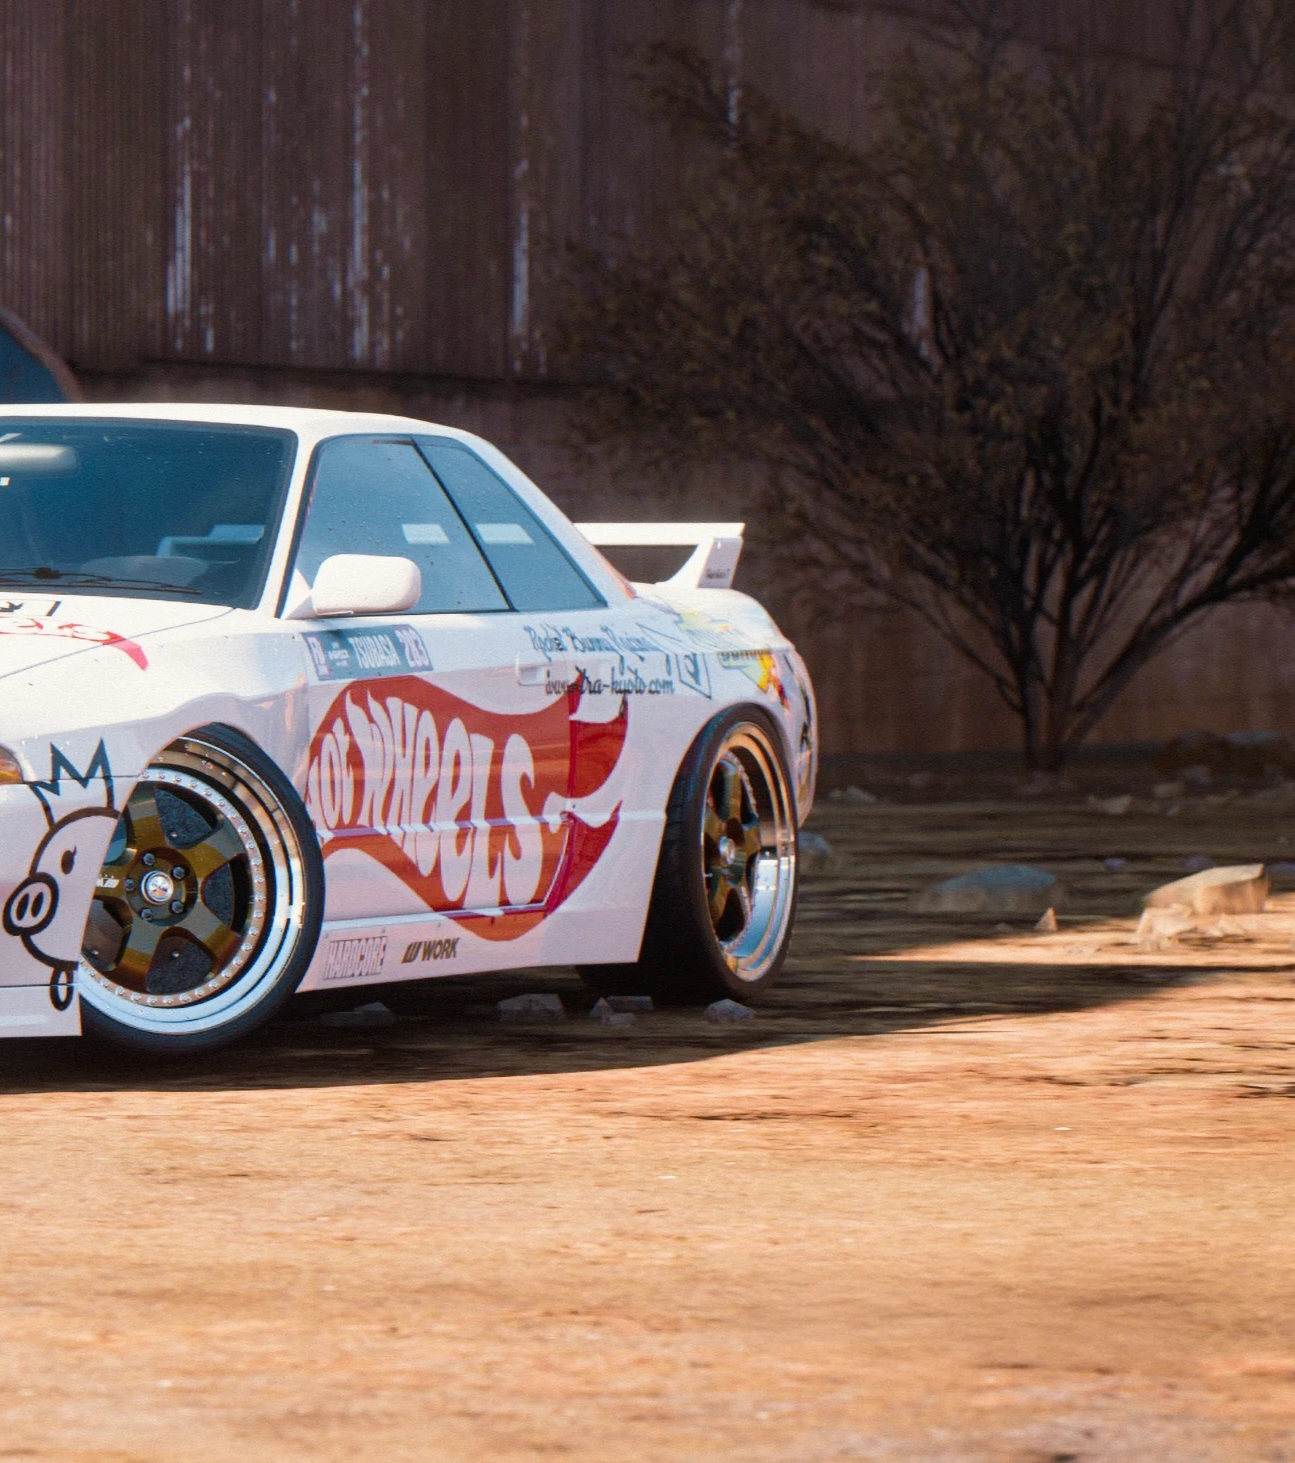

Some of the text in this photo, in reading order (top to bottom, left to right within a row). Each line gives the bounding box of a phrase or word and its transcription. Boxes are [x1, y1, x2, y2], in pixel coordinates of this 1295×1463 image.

[523, 623, 568, 662] Rocket
[562, 625, 625, 676] Bunny
[323, 936, 388, 980] HARDCORE
[421, 937, 460, 961] WORK
